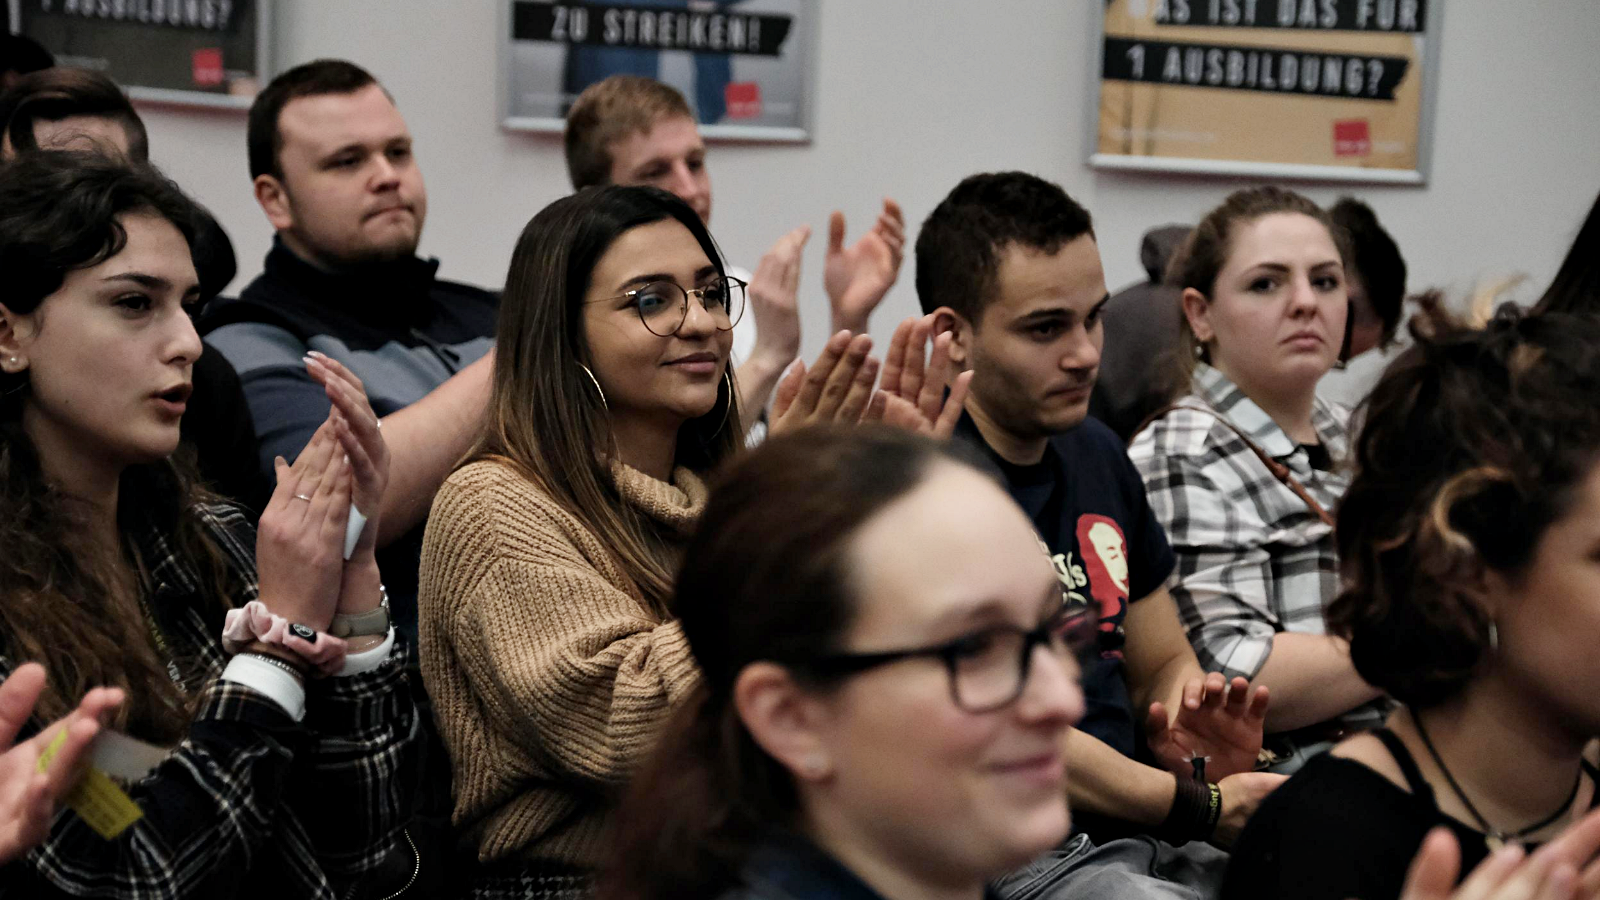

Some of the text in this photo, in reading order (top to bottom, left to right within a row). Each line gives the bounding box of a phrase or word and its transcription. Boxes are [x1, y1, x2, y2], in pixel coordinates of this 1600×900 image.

[550, 5, 762, 51] ZU STREIKEN!
[1126, 44, 1385, 96] 1 AUSBILDUNG?
